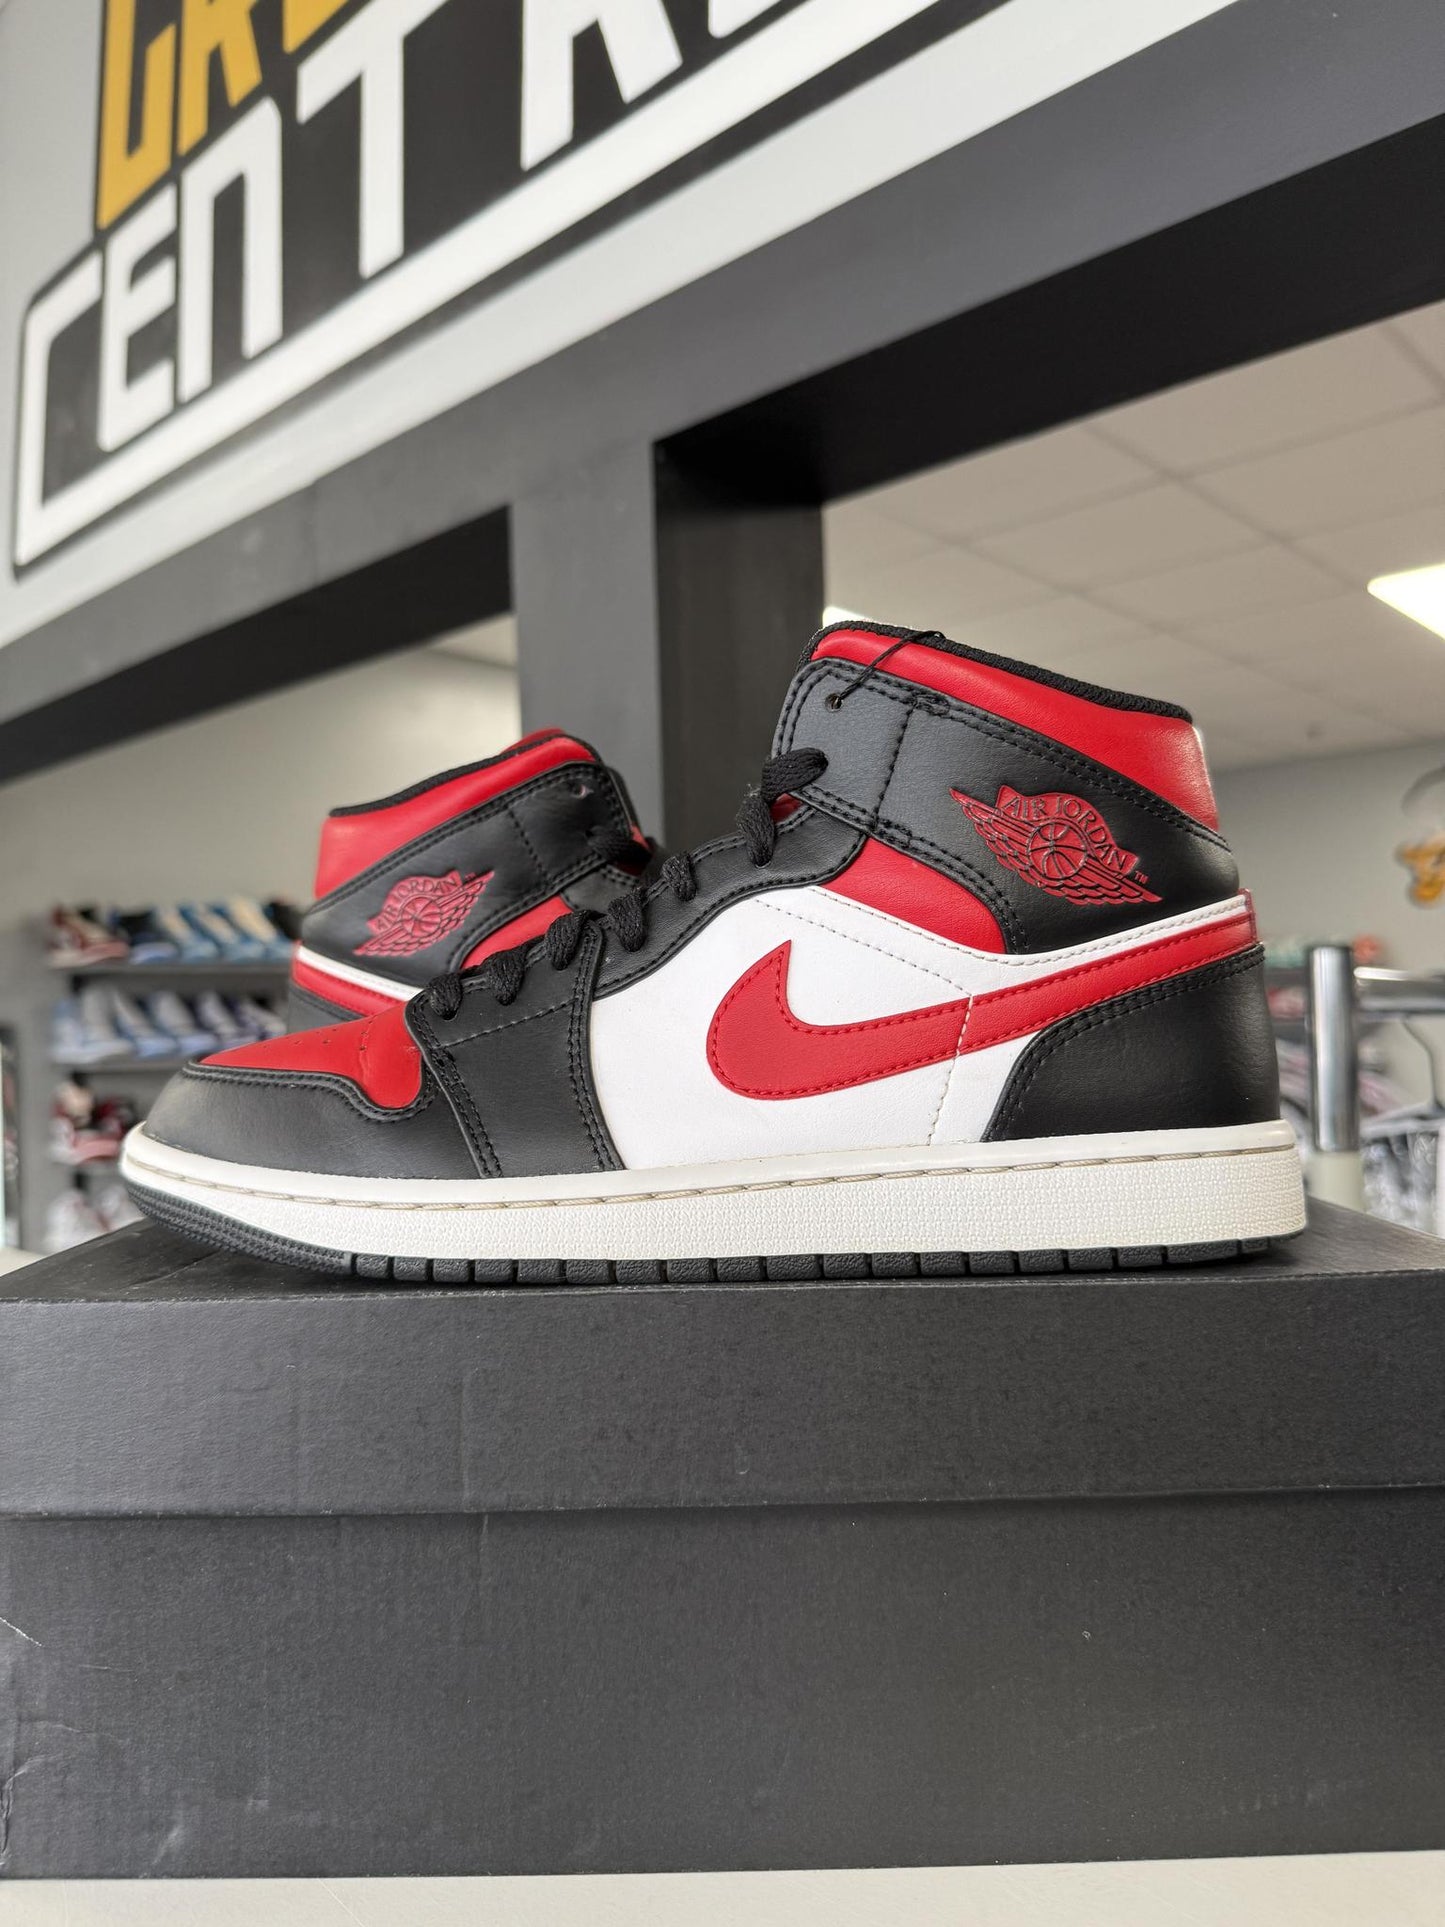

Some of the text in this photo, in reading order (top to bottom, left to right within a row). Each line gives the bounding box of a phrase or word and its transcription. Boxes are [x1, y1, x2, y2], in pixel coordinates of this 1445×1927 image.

[96, 0, 352, 231] CR
[14, 0, 790, 567] CENTR
[1001, 795, 1047, 820] AIR
[1055, 795, 1128, 871] JORDAN
